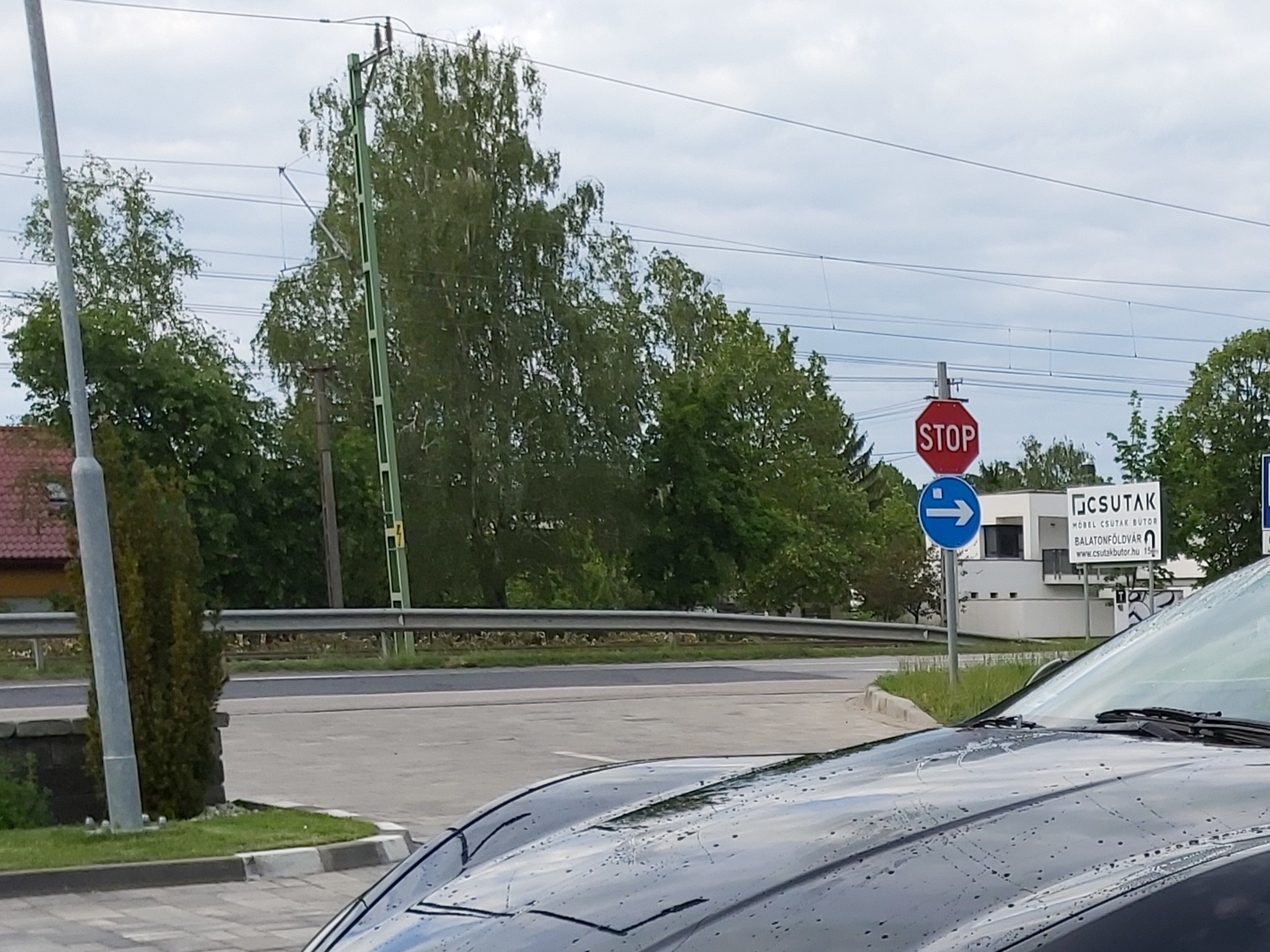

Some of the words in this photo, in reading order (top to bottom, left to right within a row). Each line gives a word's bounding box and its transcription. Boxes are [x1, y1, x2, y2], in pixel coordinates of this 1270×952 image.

[919, 423, 976, 452] STOP
[1087, 492, 1156, 514] CSUTAK
[1100, 519, 1129, 528] CSUTAK
[1074, 532, 1142, 546] BALATONFÖLDVÁR
[1076, 547, 1140, 558] www.csutakbutor.hu
